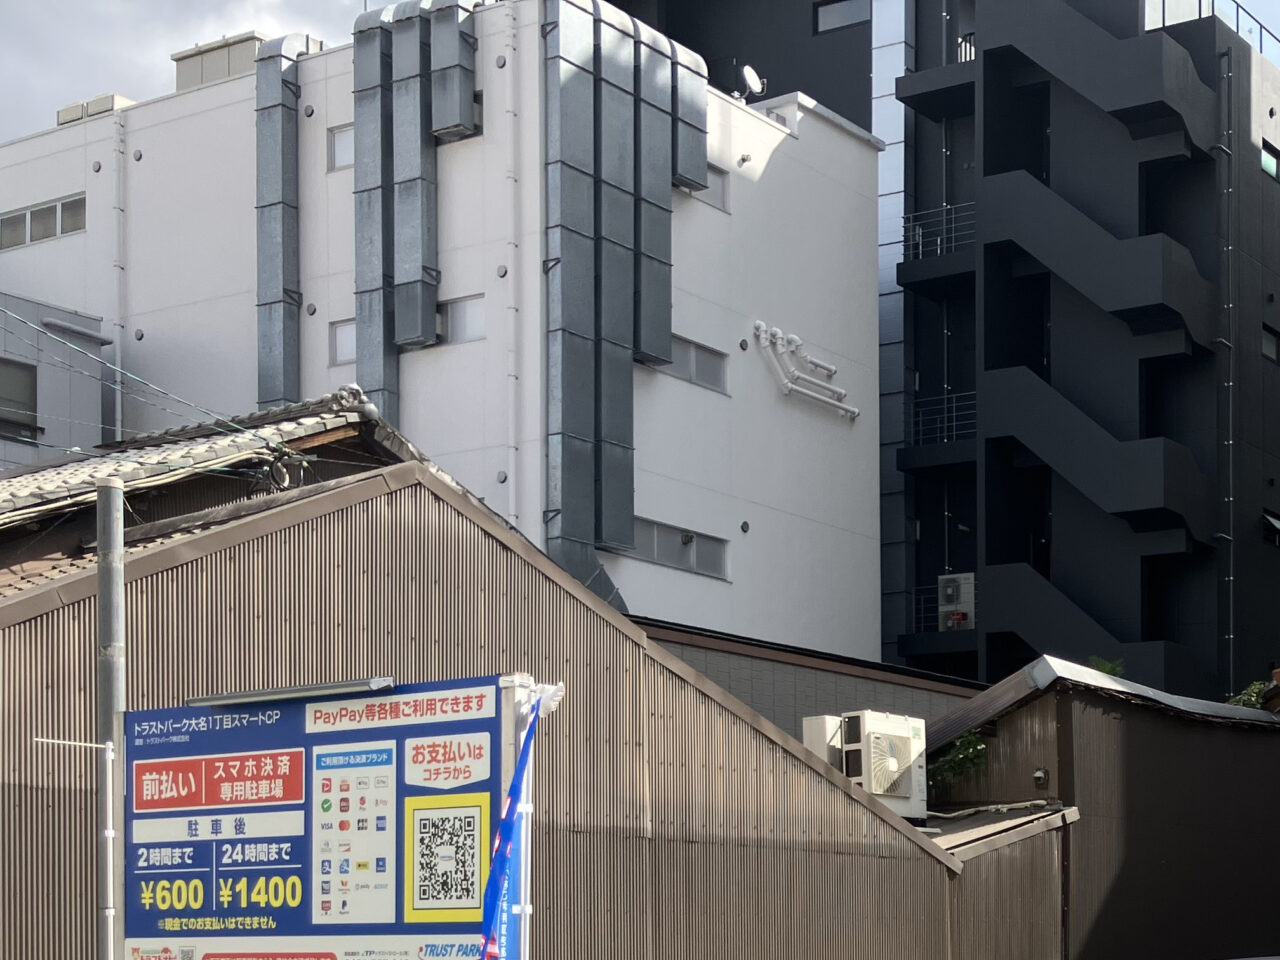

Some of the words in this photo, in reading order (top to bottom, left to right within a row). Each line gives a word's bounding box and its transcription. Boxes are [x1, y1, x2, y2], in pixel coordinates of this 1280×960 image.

[314, 693, 487, 726] PayPay等各種ご利用できます
[134, 711, 281, 736] トラストパーク大名1丁目スマートCP
[411, 741, 484, 765] お支払いは
[213, 756, 291, 780] スマホ決済
[423, 765, 472, 782] コチラから
[142, 771, 196, 801] 前払い
[220, 779, 284, 802] 専用駐車場
[187, 817, 247, 838] 駐車後
[137, 847, 194, 867] 2時間まで
[221, 843, 292, 864] 24時間まで
[141, 879, 204, 911] ¥600
[219, 875, 303, 909] ¥1400
[424, 943, 456, 957] TRUST
